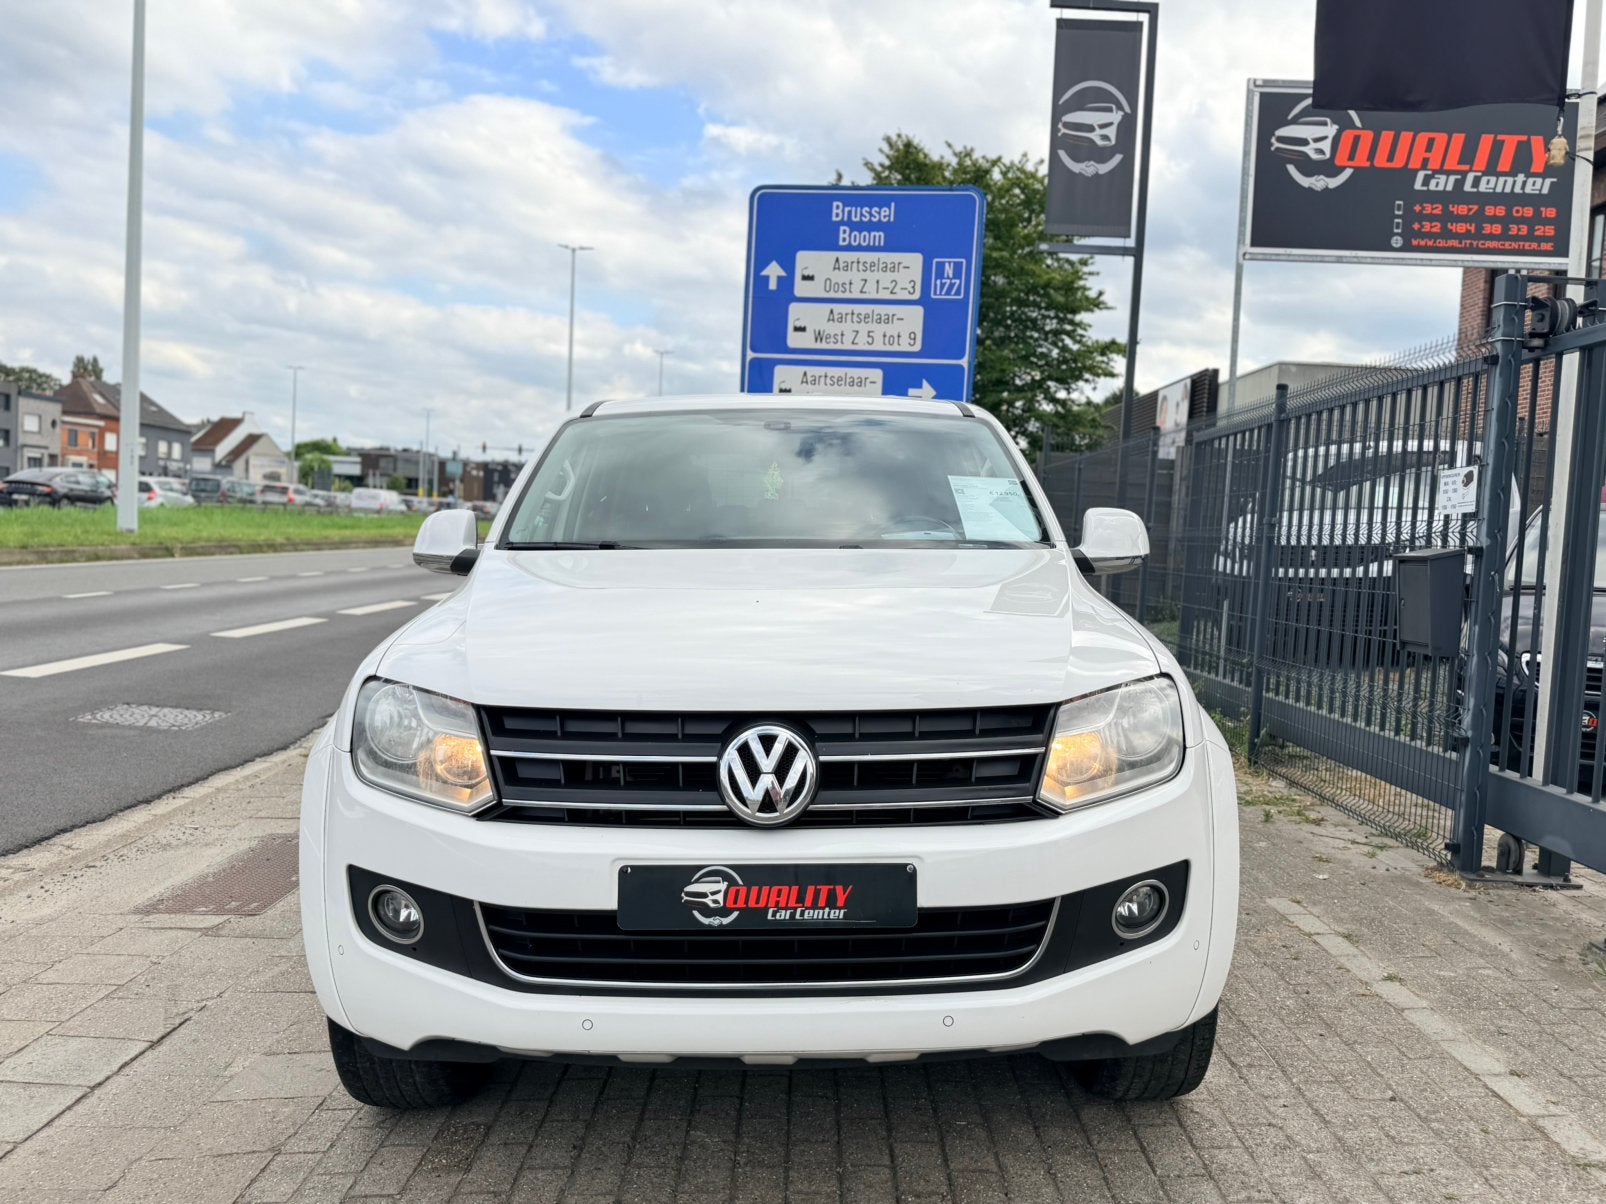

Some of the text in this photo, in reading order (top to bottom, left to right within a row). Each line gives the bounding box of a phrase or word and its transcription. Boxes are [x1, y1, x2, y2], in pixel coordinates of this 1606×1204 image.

[1334, 129, 1550, 173] QUALITY
[1414, 170, 1557, 194] Car Center
[832, 201, 895, 222] Brussel
[1413, 203, 1557, 218] +32 487 96 09 18
[838, 226, 885, 247] Boom
[1412, 221, 1555, 237] +32 484 38 33 25
[832, 256, 910, 274] Aartselaar-
[944, 262, 954, 278] N
[824, 277, 853, 294] Oost
[936, 279, 960, 296] 177
[827, 308, 904, 325] Aartselaar-
[813, 329, 844, 346] West
[882, 331, 903, 347] tot
[908, 331, 917, 347] 9
[800, 370, 877, 388] Aartselaar-
[726, 885, 853, 908] QUALITY
[767, 907, 847, 920] Car Center
